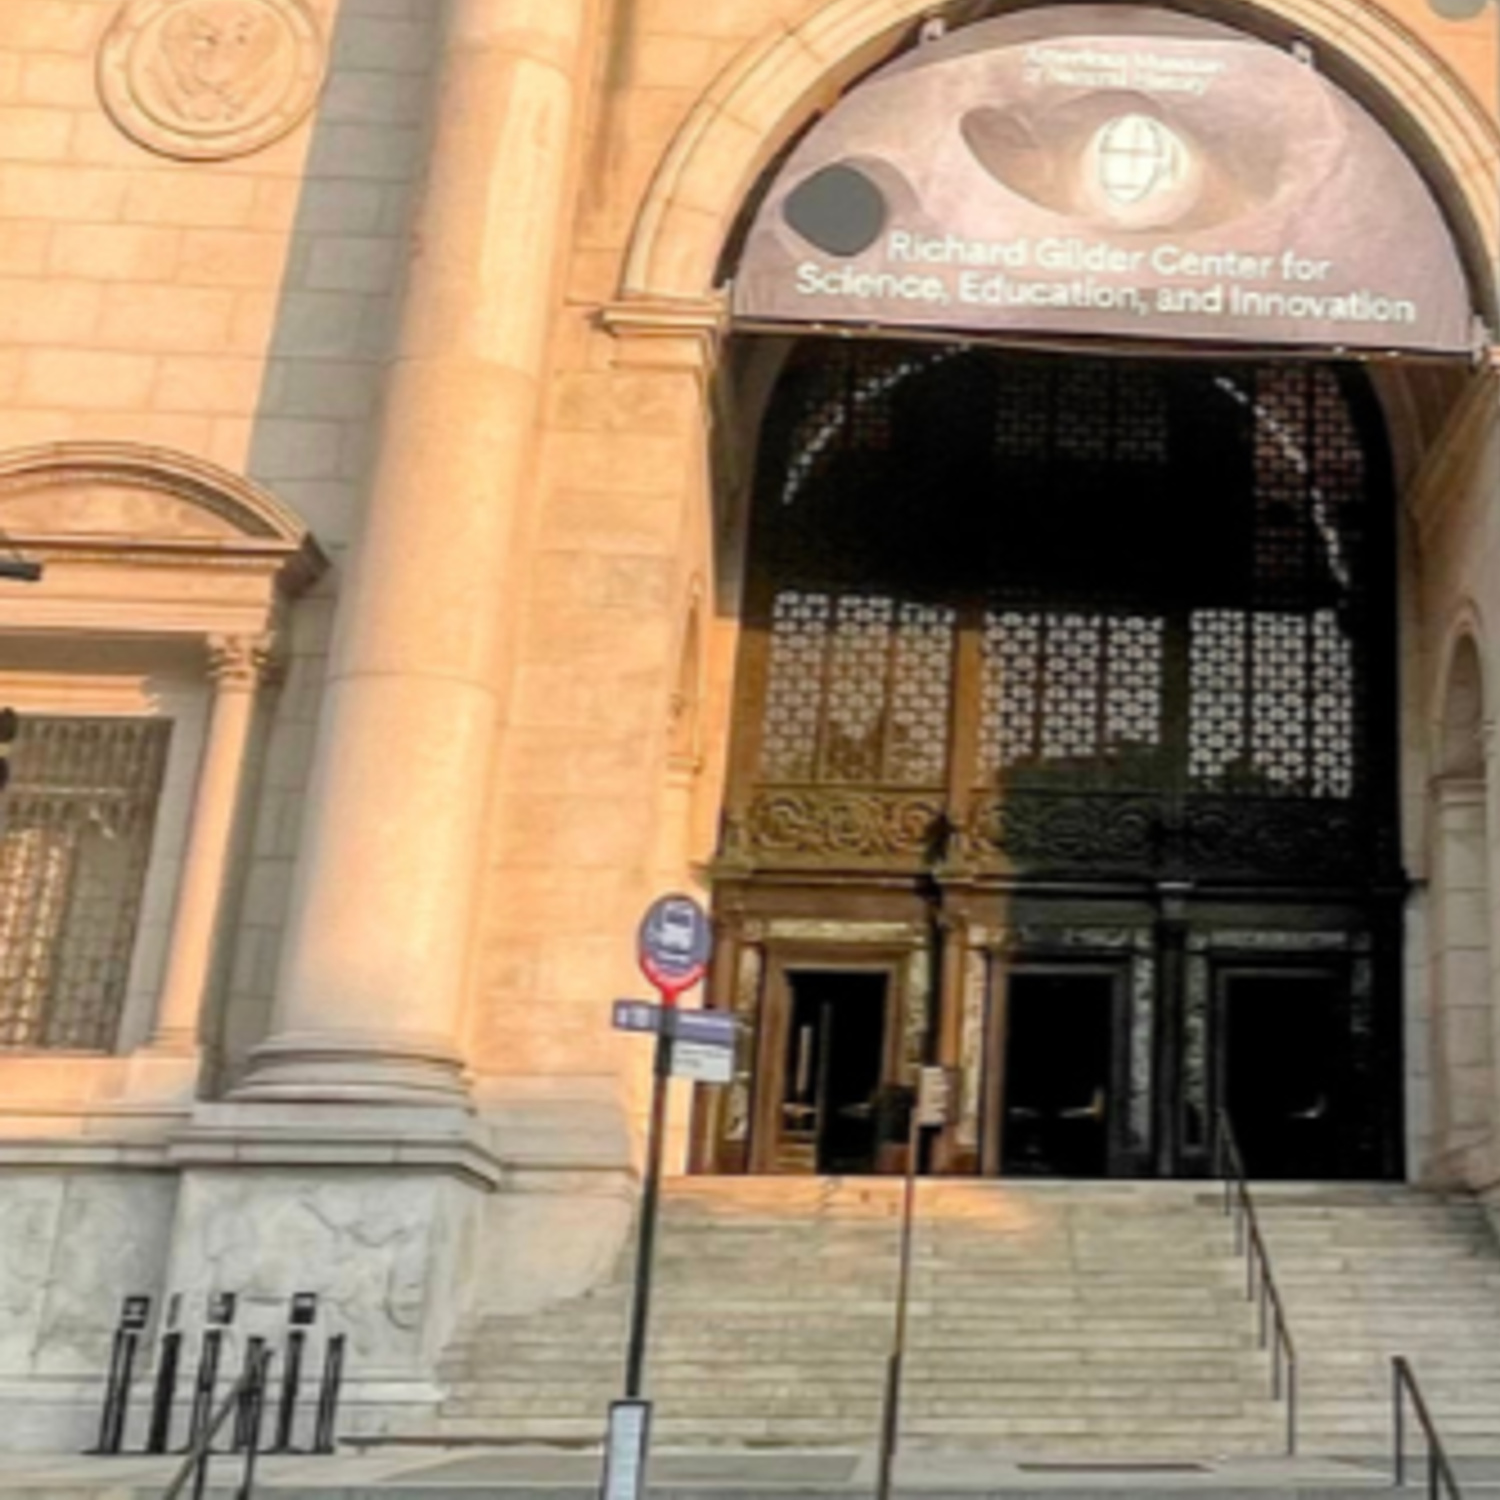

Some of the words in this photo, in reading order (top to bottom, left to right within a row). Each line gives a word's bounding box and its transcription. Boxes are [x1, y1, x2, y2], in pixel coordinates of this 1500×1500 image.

[888, 231, 1029, 269] Richard
[1034, 237, 1142, 274] Gilder
[1150, 244, 1274, 280] Center
[1281, 251, 1334, 282] for
[795, 262, 949, 307] Science,
[958, 271, 1148, 316] Education,
[1156, 285, 1224, 314] and
[1230, 286, 1417, 323] Innovation
